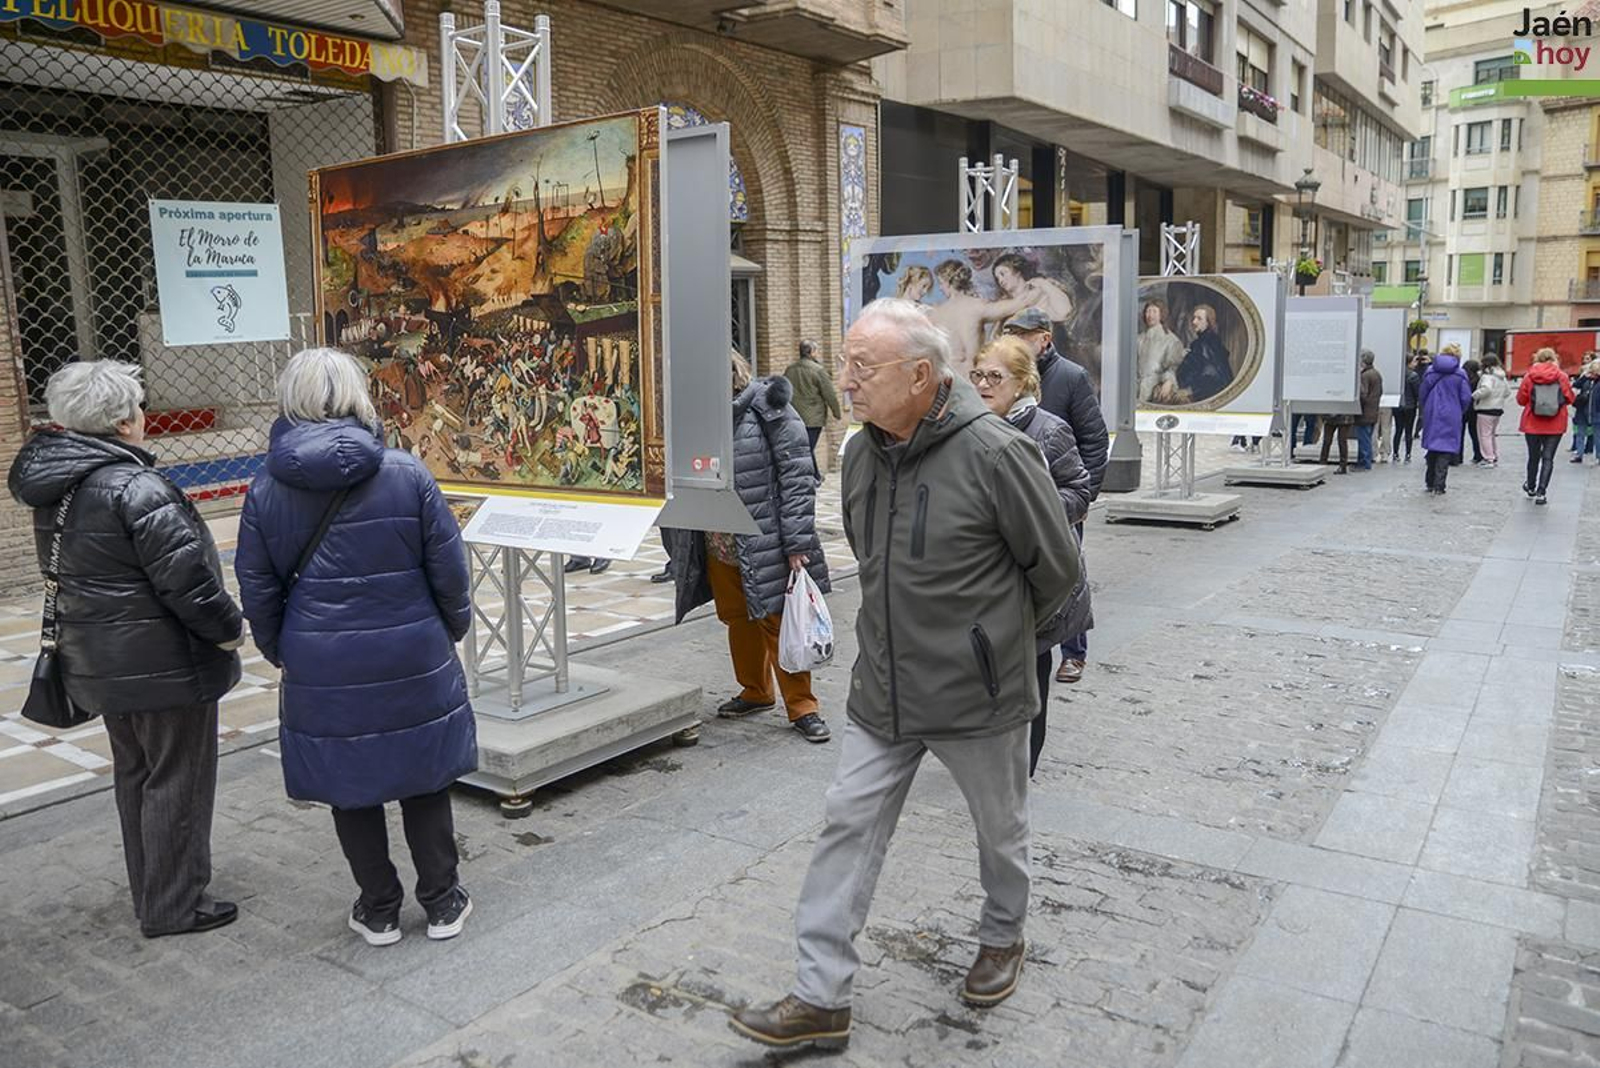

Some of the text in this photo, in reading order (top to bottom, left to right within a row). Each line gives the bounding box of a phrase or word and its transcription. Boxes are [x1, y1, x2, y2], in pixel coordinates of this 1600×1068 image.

[268, 26, 414, 77] TOLEDANO
[158, 207, 273, 223] Próxima apertura
[179, 227, 260, 249] El Morro de
[48, 533, 62, 574] BIMBA
